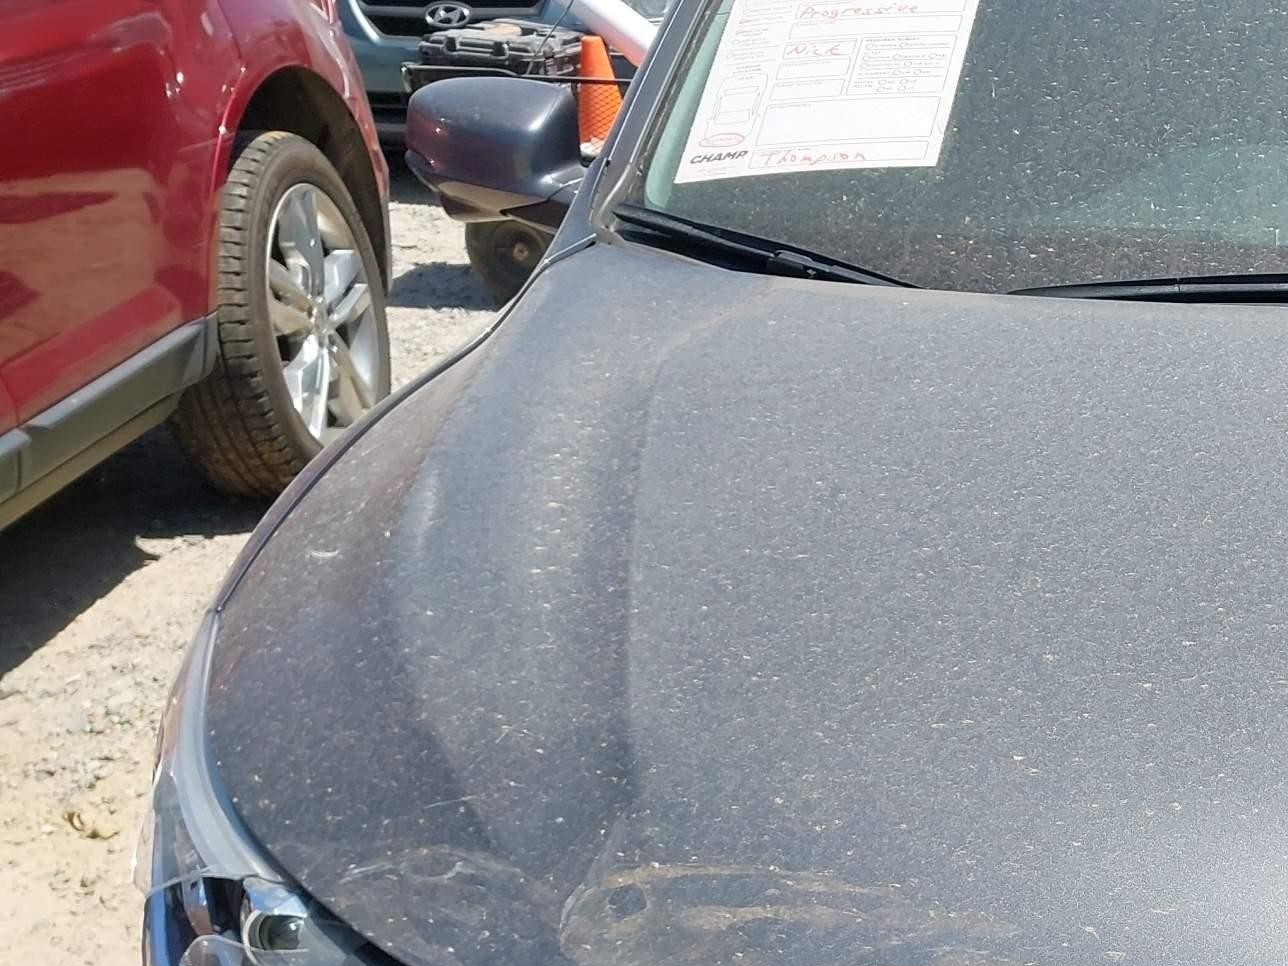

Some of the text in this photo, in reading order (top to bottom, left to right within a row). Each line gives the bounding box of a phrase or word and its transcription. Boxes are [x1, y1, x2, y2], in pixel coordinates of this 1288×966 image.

[800, 2, 919, 19] Progressive
[785, 43, 842, 57] Nick
[690, 150, 749, 165] CHAMP
